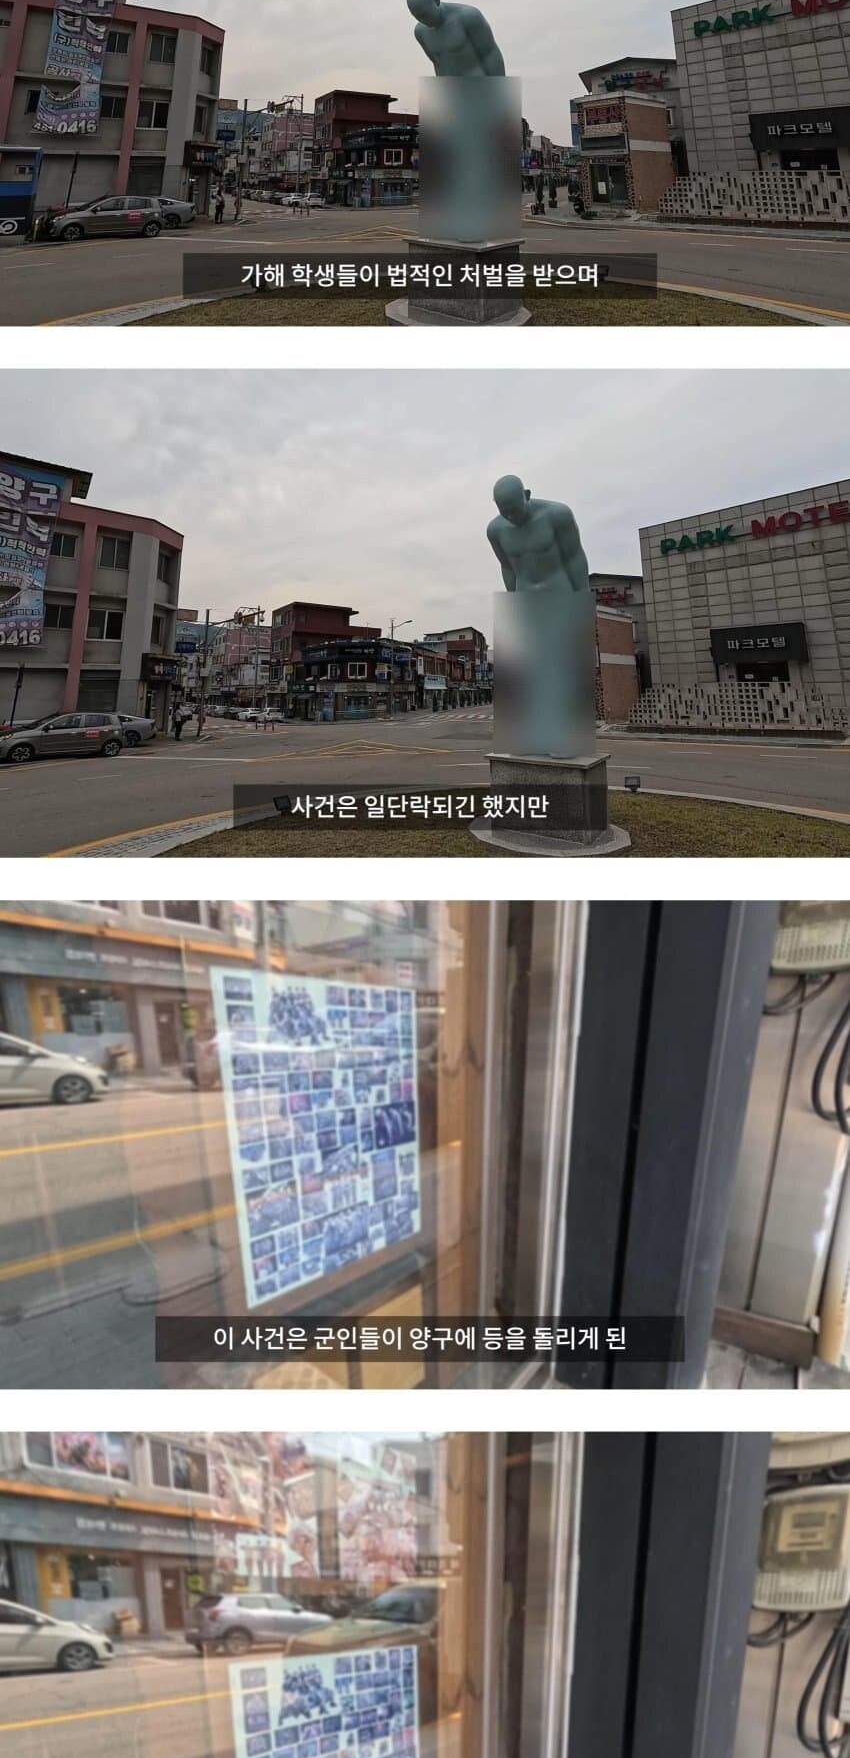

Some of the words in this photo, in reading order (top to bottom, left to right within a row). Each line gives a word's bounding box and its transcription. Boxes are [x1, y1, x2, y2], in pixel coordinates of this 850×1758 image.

[693, 3, 775, 37] PARK
[767, 120, 833, 136] 파크모텔
[660, 524, 736, 556] PARK
[727, 636, 786, 651] 파크모텔
